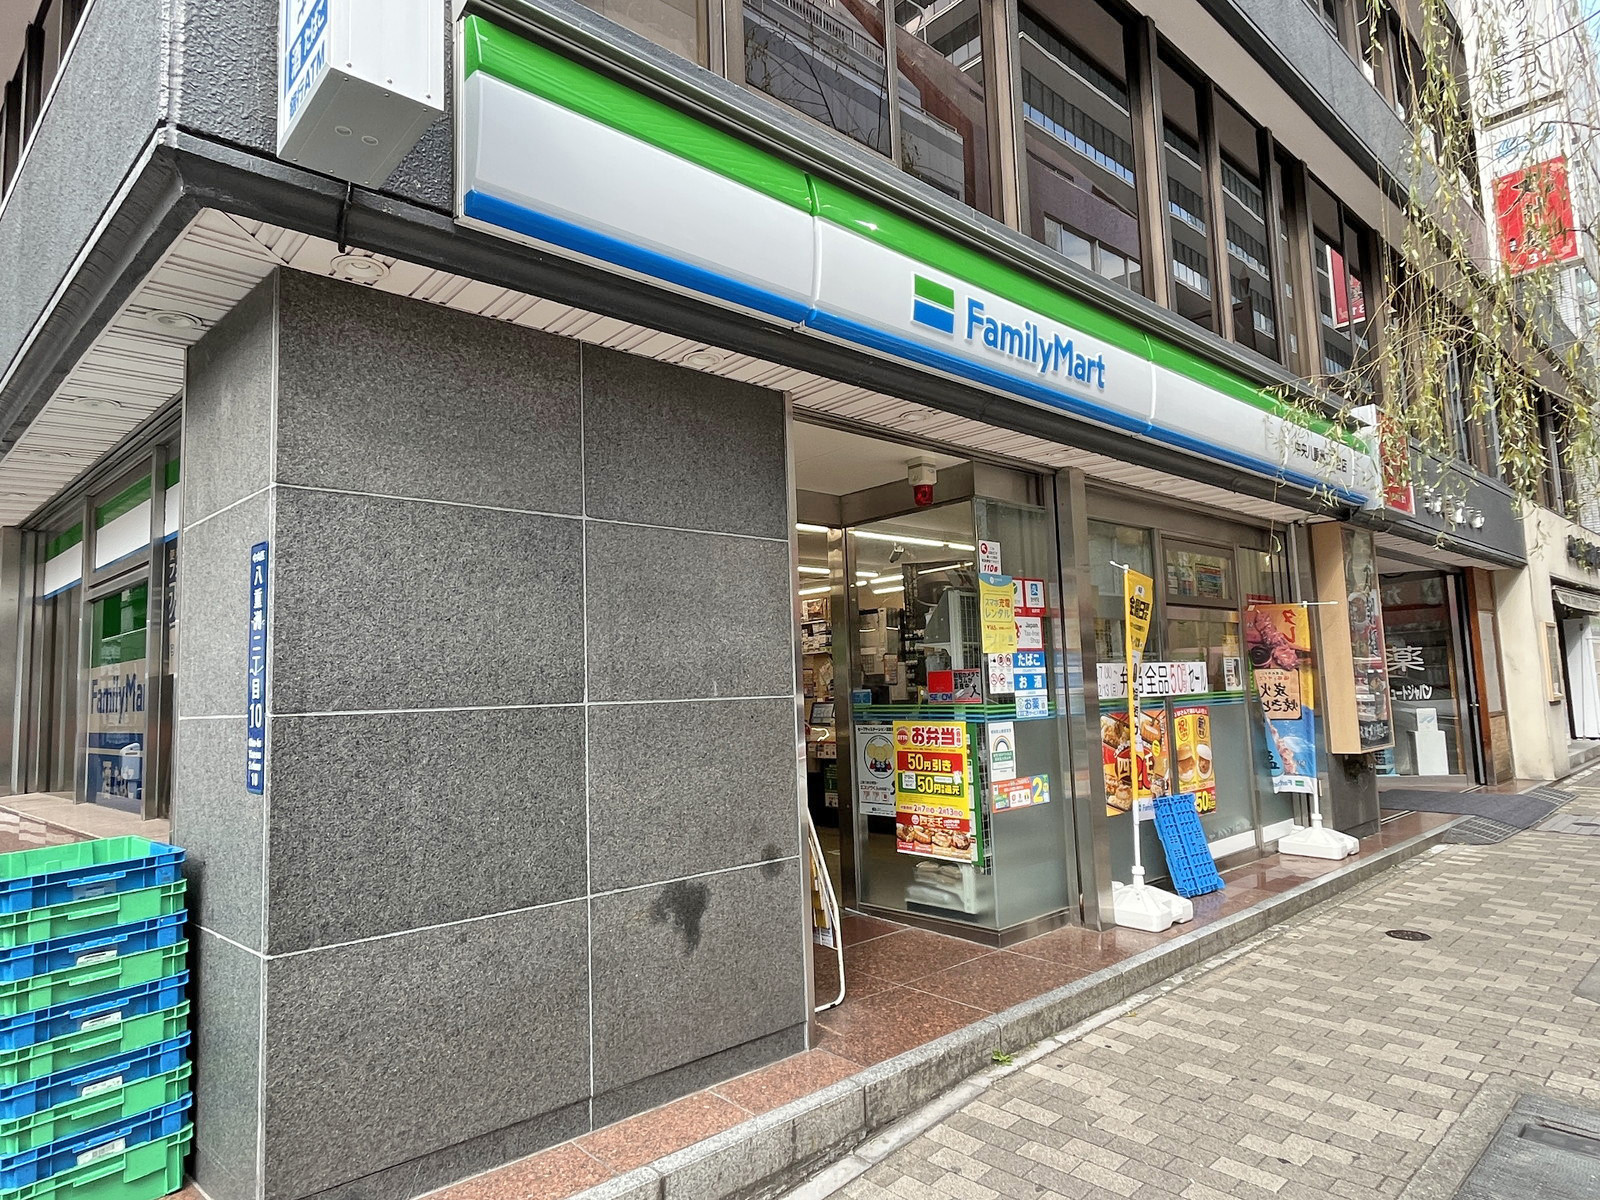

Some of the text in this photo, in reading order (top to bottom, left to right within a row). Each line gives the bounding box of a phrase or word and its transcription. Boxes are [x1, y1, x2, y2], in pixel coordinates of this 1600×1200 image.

[966, 297, 1105, 389] FamilyMart
[985, 608, 1010, 619] レンタル
[1017, 653, 1041, 667] たばこ
[1386, 646, 1425, 672] 薬
[929, 693, 953, 701] SEOM
[911, 725, 955, 746] お弁当
[907, 753, 952, 772] 50円引き
